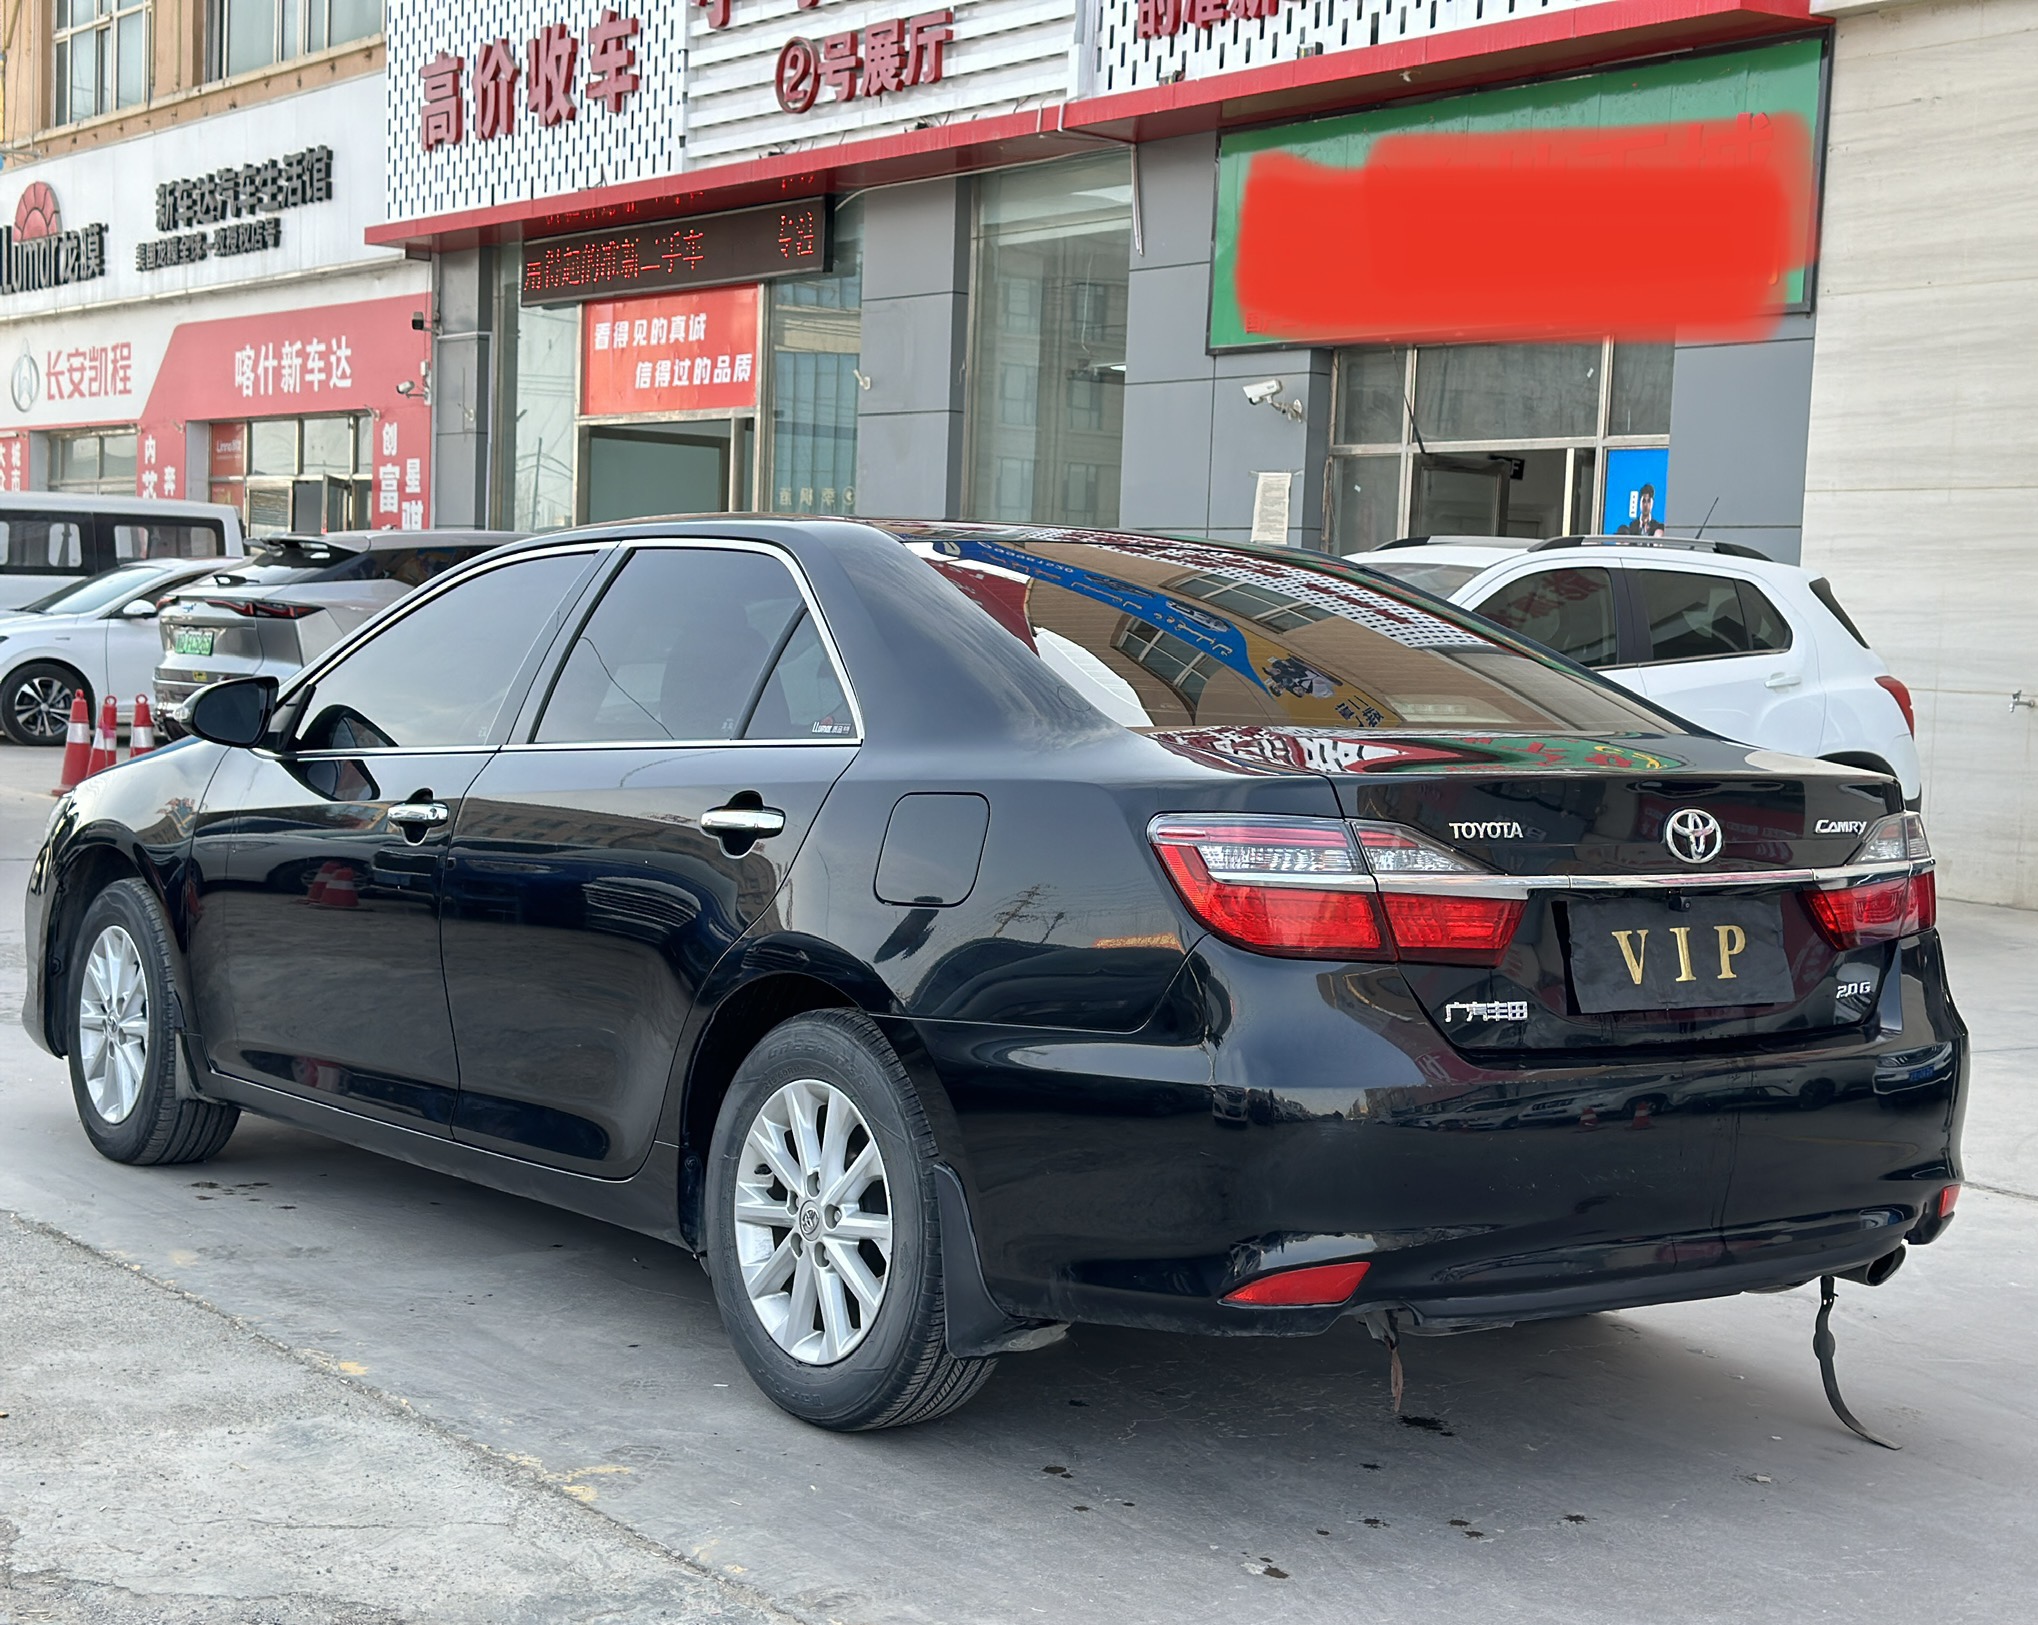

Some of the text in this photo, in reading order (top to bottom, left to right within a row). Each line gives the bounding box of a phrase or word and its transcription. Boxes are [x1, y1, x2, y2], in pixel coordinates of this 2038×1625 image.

[420, 9, 639, 152] 高价收车
[156, 145, 334, 231] 新车达汽车生活馆
[594, 313, 707, 351] 看得见的真诚
[46, 342, 132, 401] 长安凯程
[234, 335, 353, 398] 喀什新车达
[634, 353, 753, 390] 信得过的品质
[1449, 822, 1524, 839] TOYOTA
[1611, 925, 1746, 985] VIP
[1445, 1001, 1528, 1022] 广汽丰田
